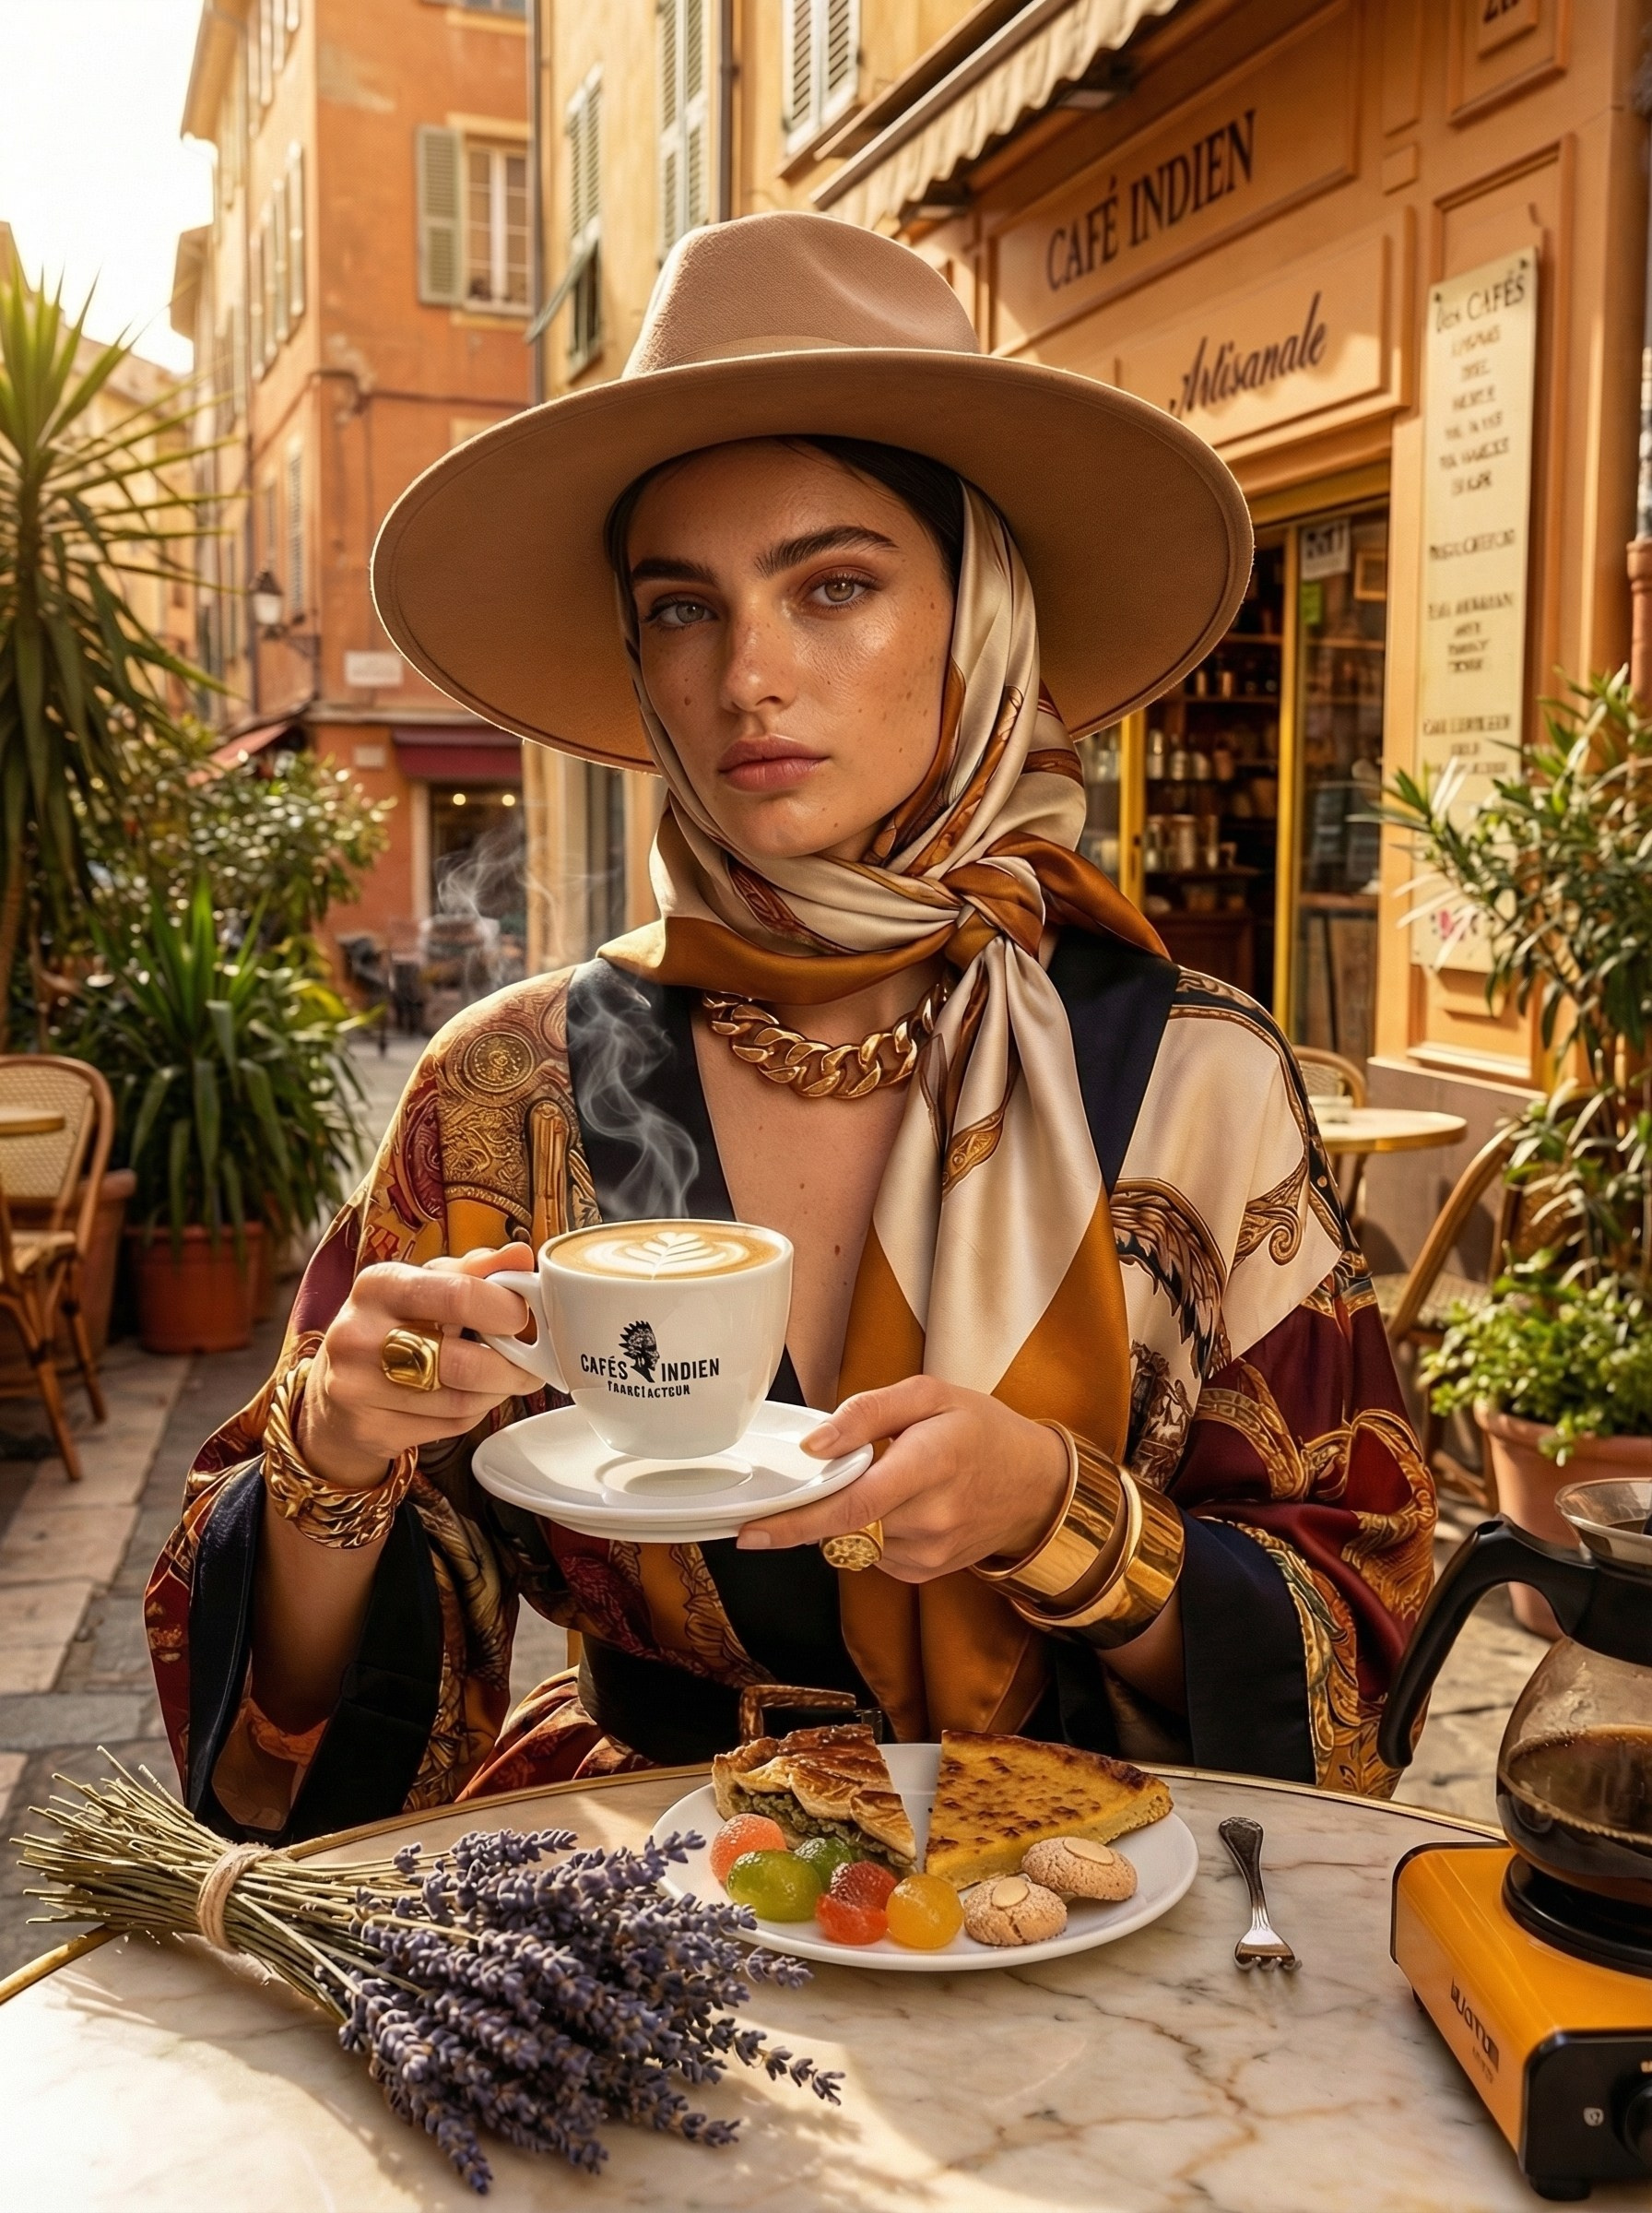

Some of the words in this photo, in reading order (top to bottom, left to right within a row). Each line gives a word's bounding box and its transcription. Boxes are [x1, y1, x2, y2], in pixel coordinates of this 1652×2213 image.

[1047, 174, 1119, 291] CAFÉ
[1130, 109, 1256, 247] INDIEN
[581, 1354, 629, 1380] CAFÉS
[661, 1357, 720, 1382] INDIEN
